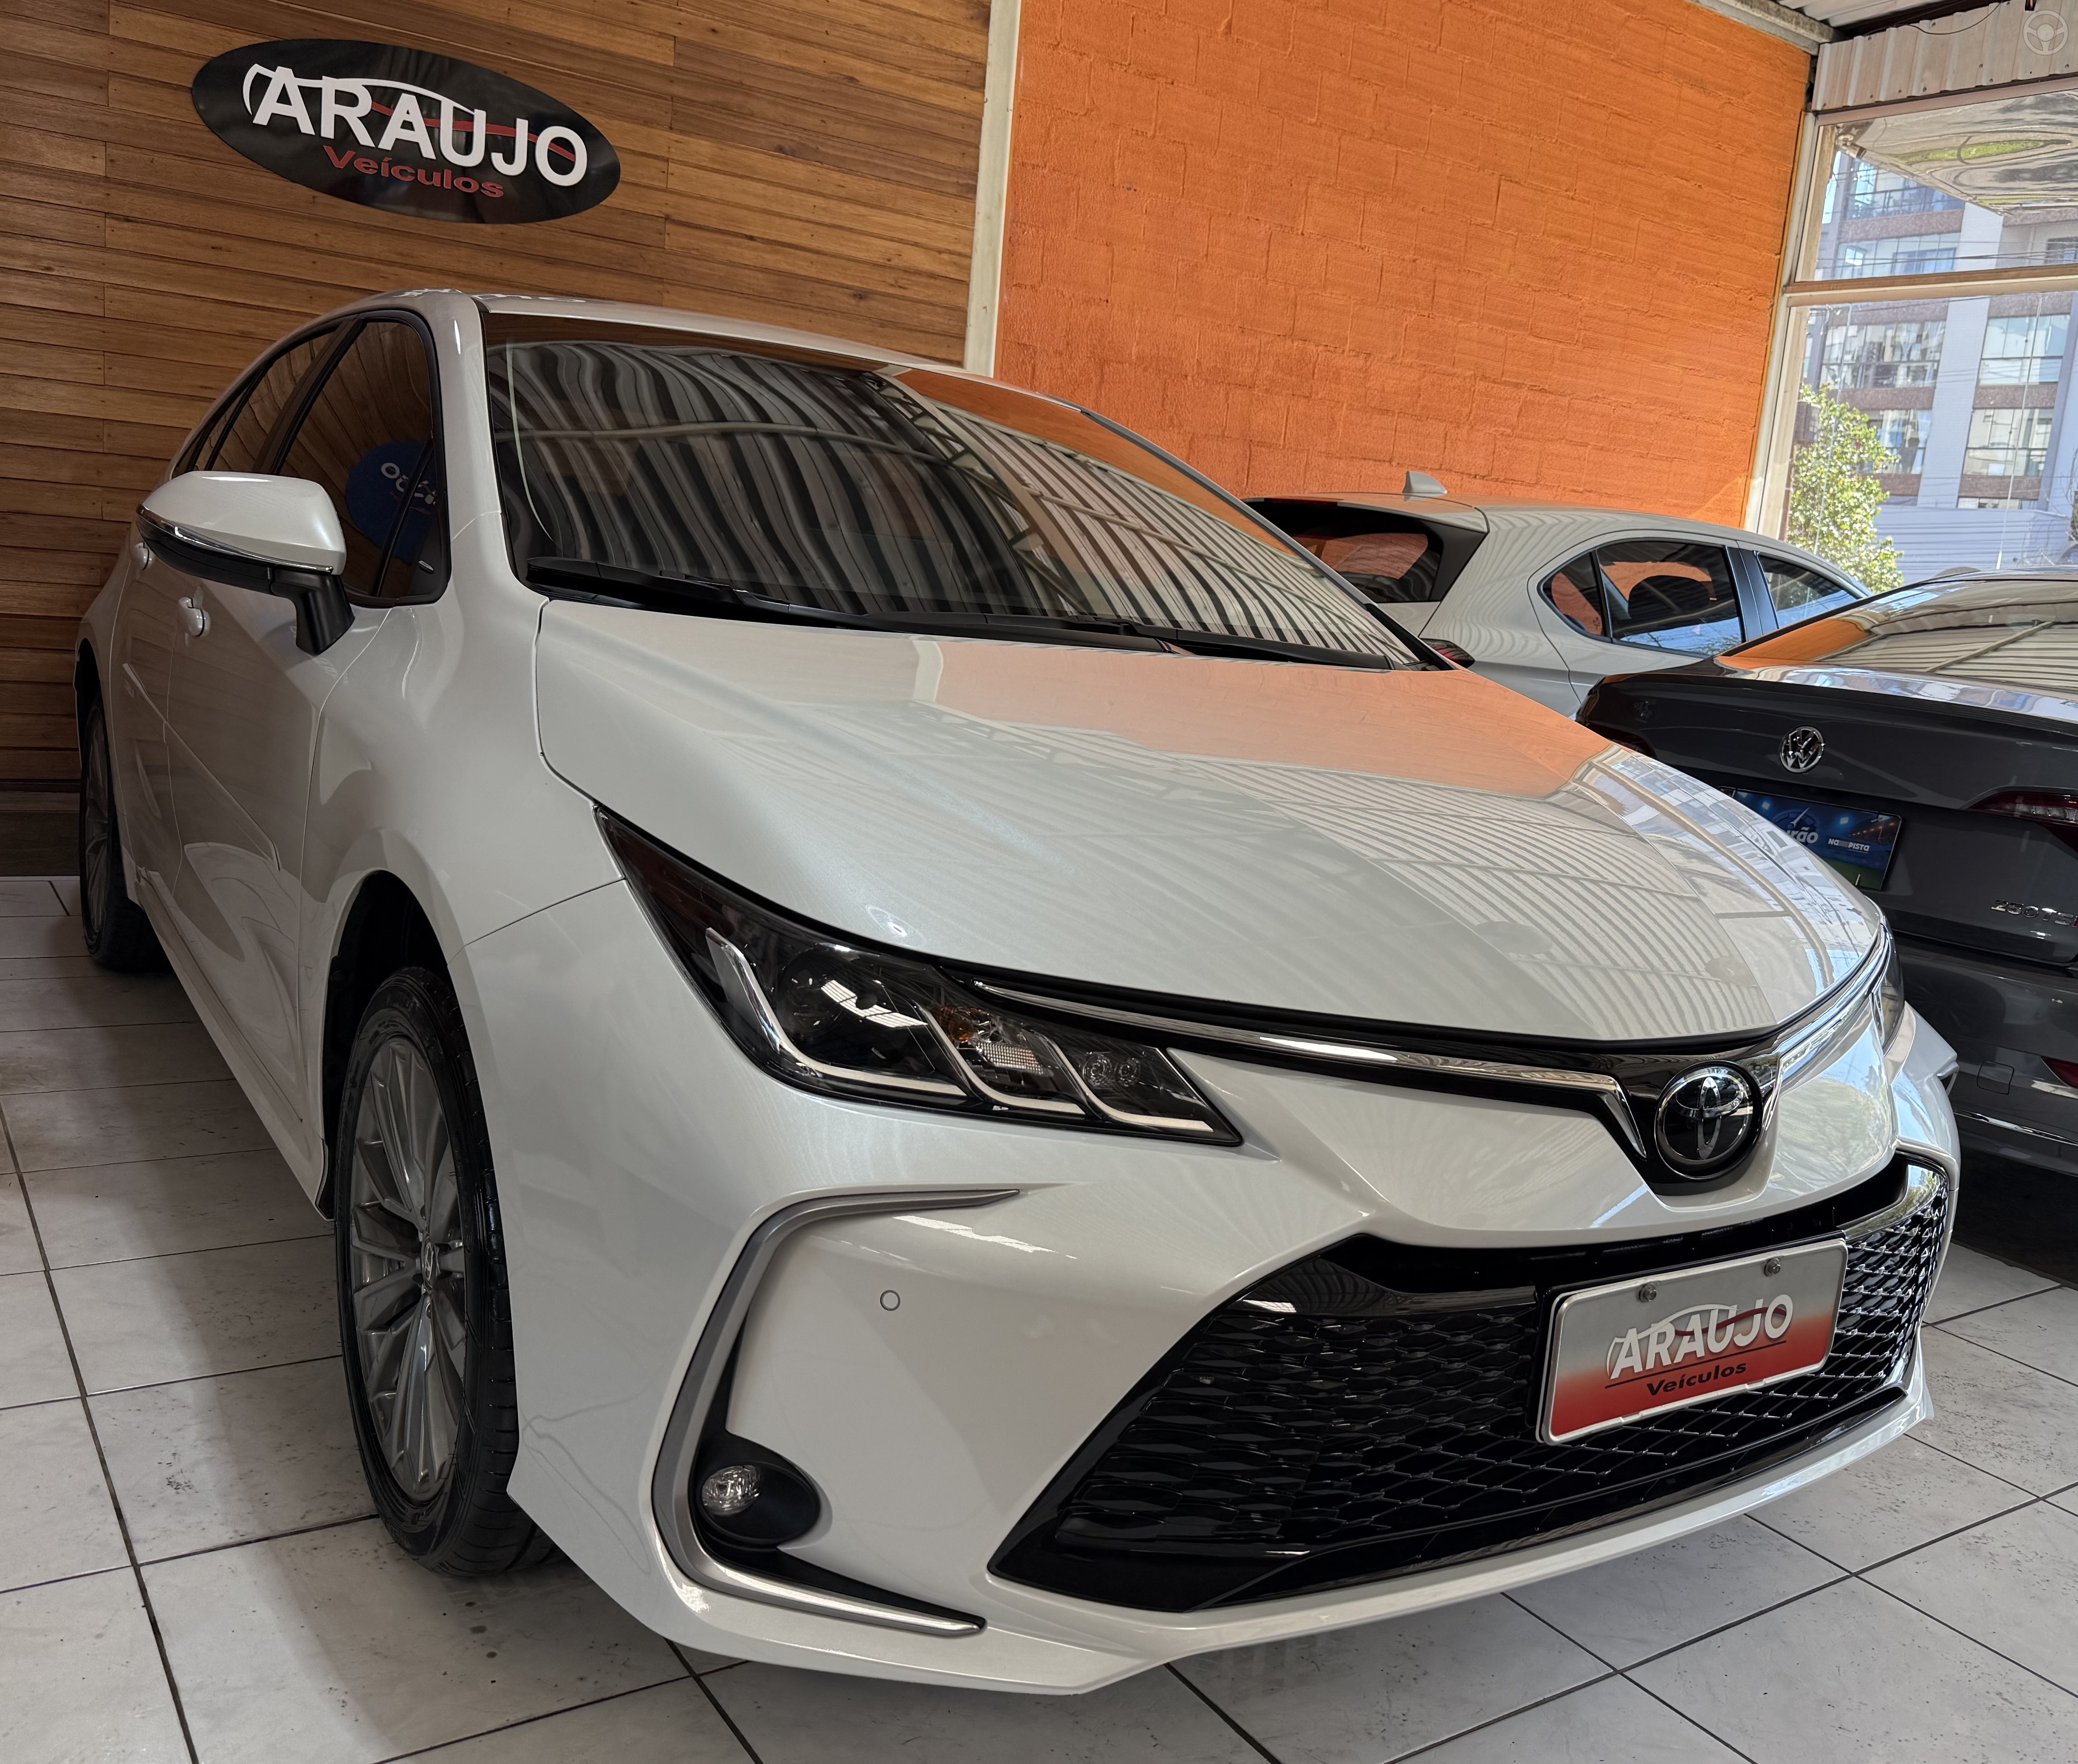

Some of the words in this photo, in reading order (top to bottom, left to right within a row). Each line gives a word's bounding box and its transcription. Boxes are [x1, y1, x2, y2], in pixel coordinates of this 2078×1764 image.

[251, 65, 588, 186] ARAUJO
[323, 145, 504, 198] Veículos
[1609, 1294, 1794, 1379] ARAUJO
[1646, 1362, 1747, 1396] Veículos
